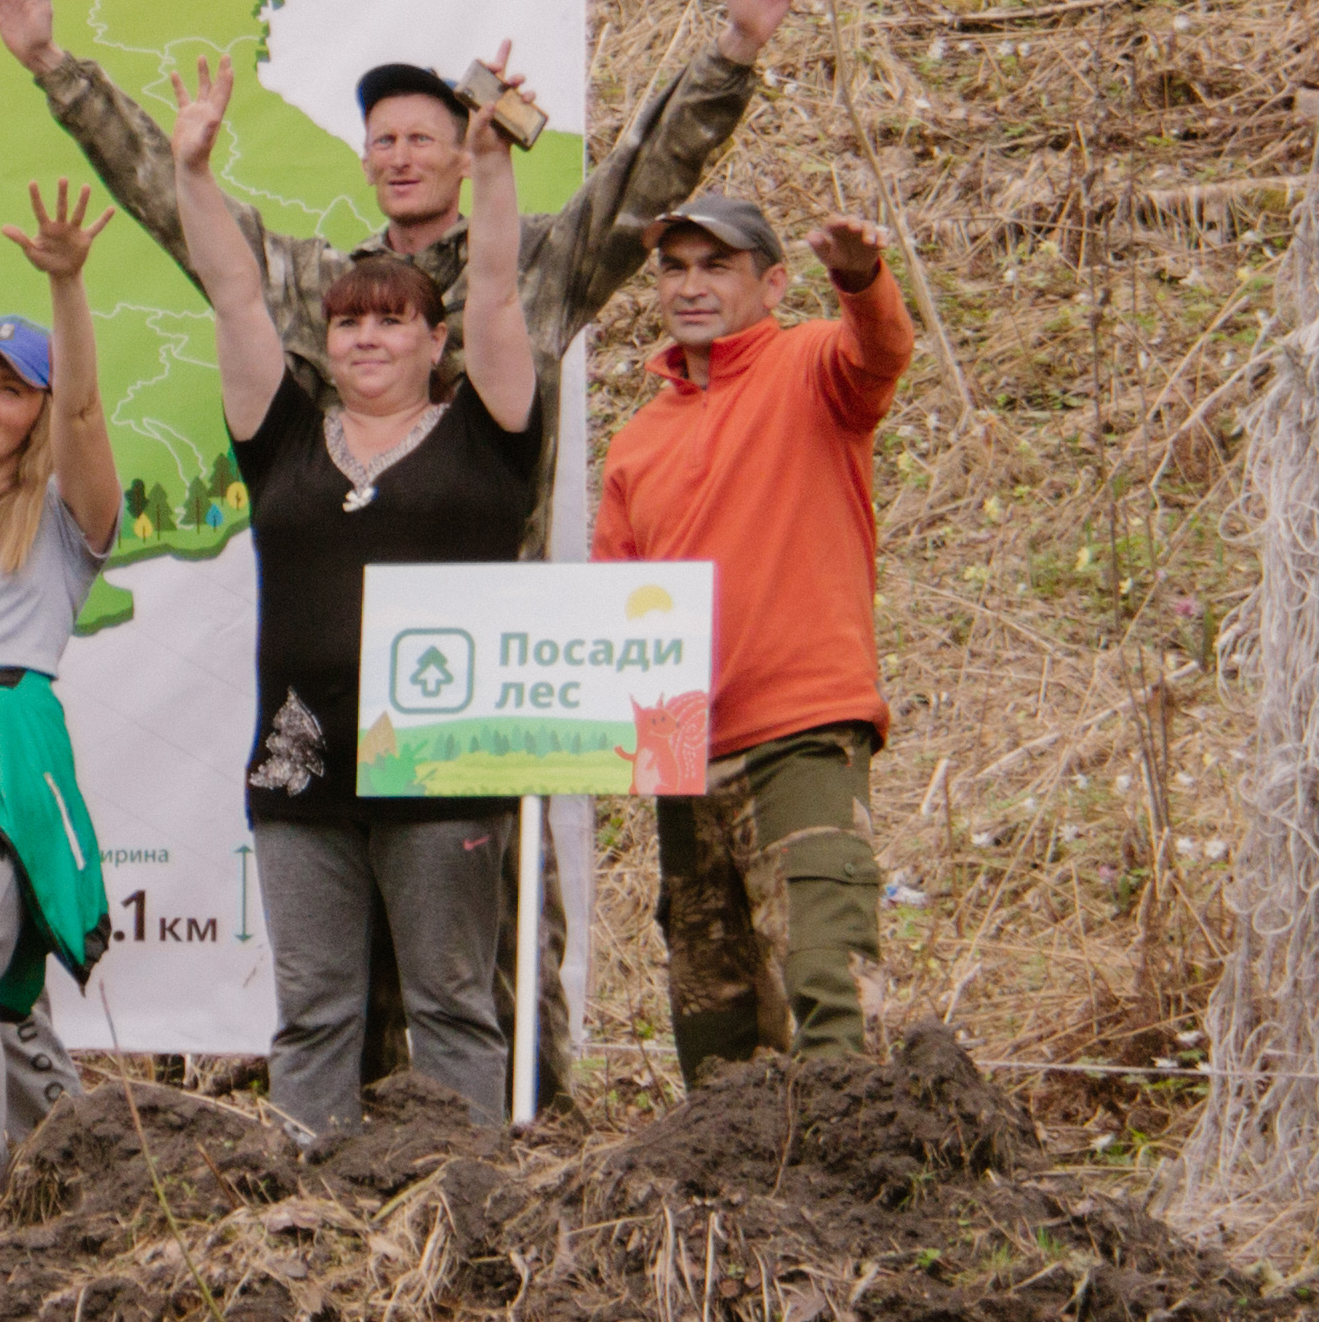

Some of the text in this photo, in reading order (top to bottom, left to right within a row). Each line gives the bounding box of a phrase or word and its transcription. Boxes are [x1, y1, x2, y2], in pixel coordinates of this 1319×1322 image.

[498, 631, 684, 673] Посади
[493, 681, 580, 710] лес
[100, 848, 169, 868] ирина
[112, 889, 217, 942] .1 км
